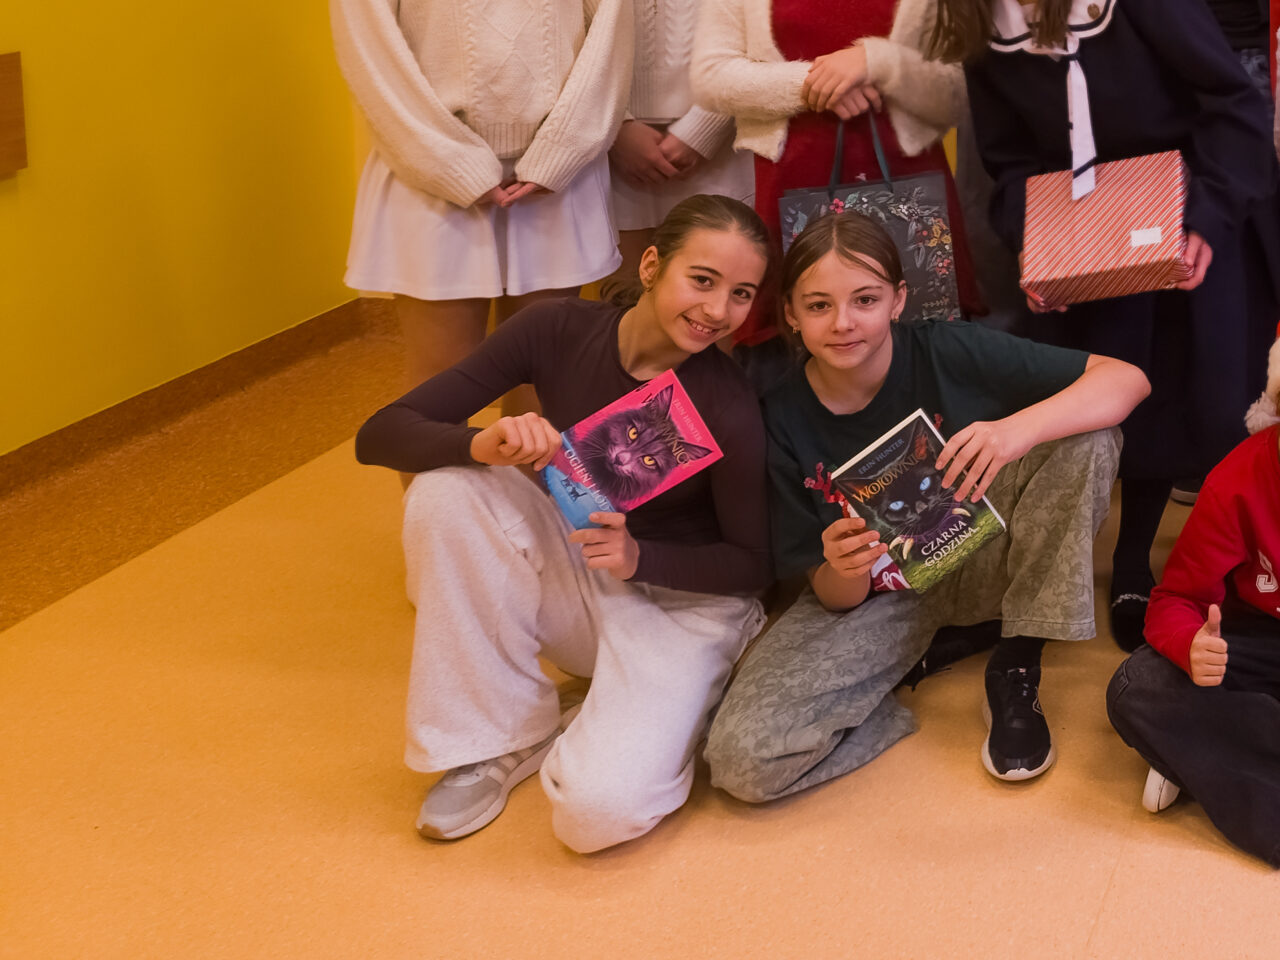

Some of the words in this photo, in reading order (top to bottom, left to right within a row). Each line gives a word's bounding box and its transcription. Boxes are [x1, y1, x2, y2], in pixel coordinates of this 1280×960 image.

[876, 438, 905, 462] HUNTER
[852, 448, 924, 503] WOJOWNI
[921, 519, 968, 556] CZARNA
[924, 526, 981, 567] GODZINA
